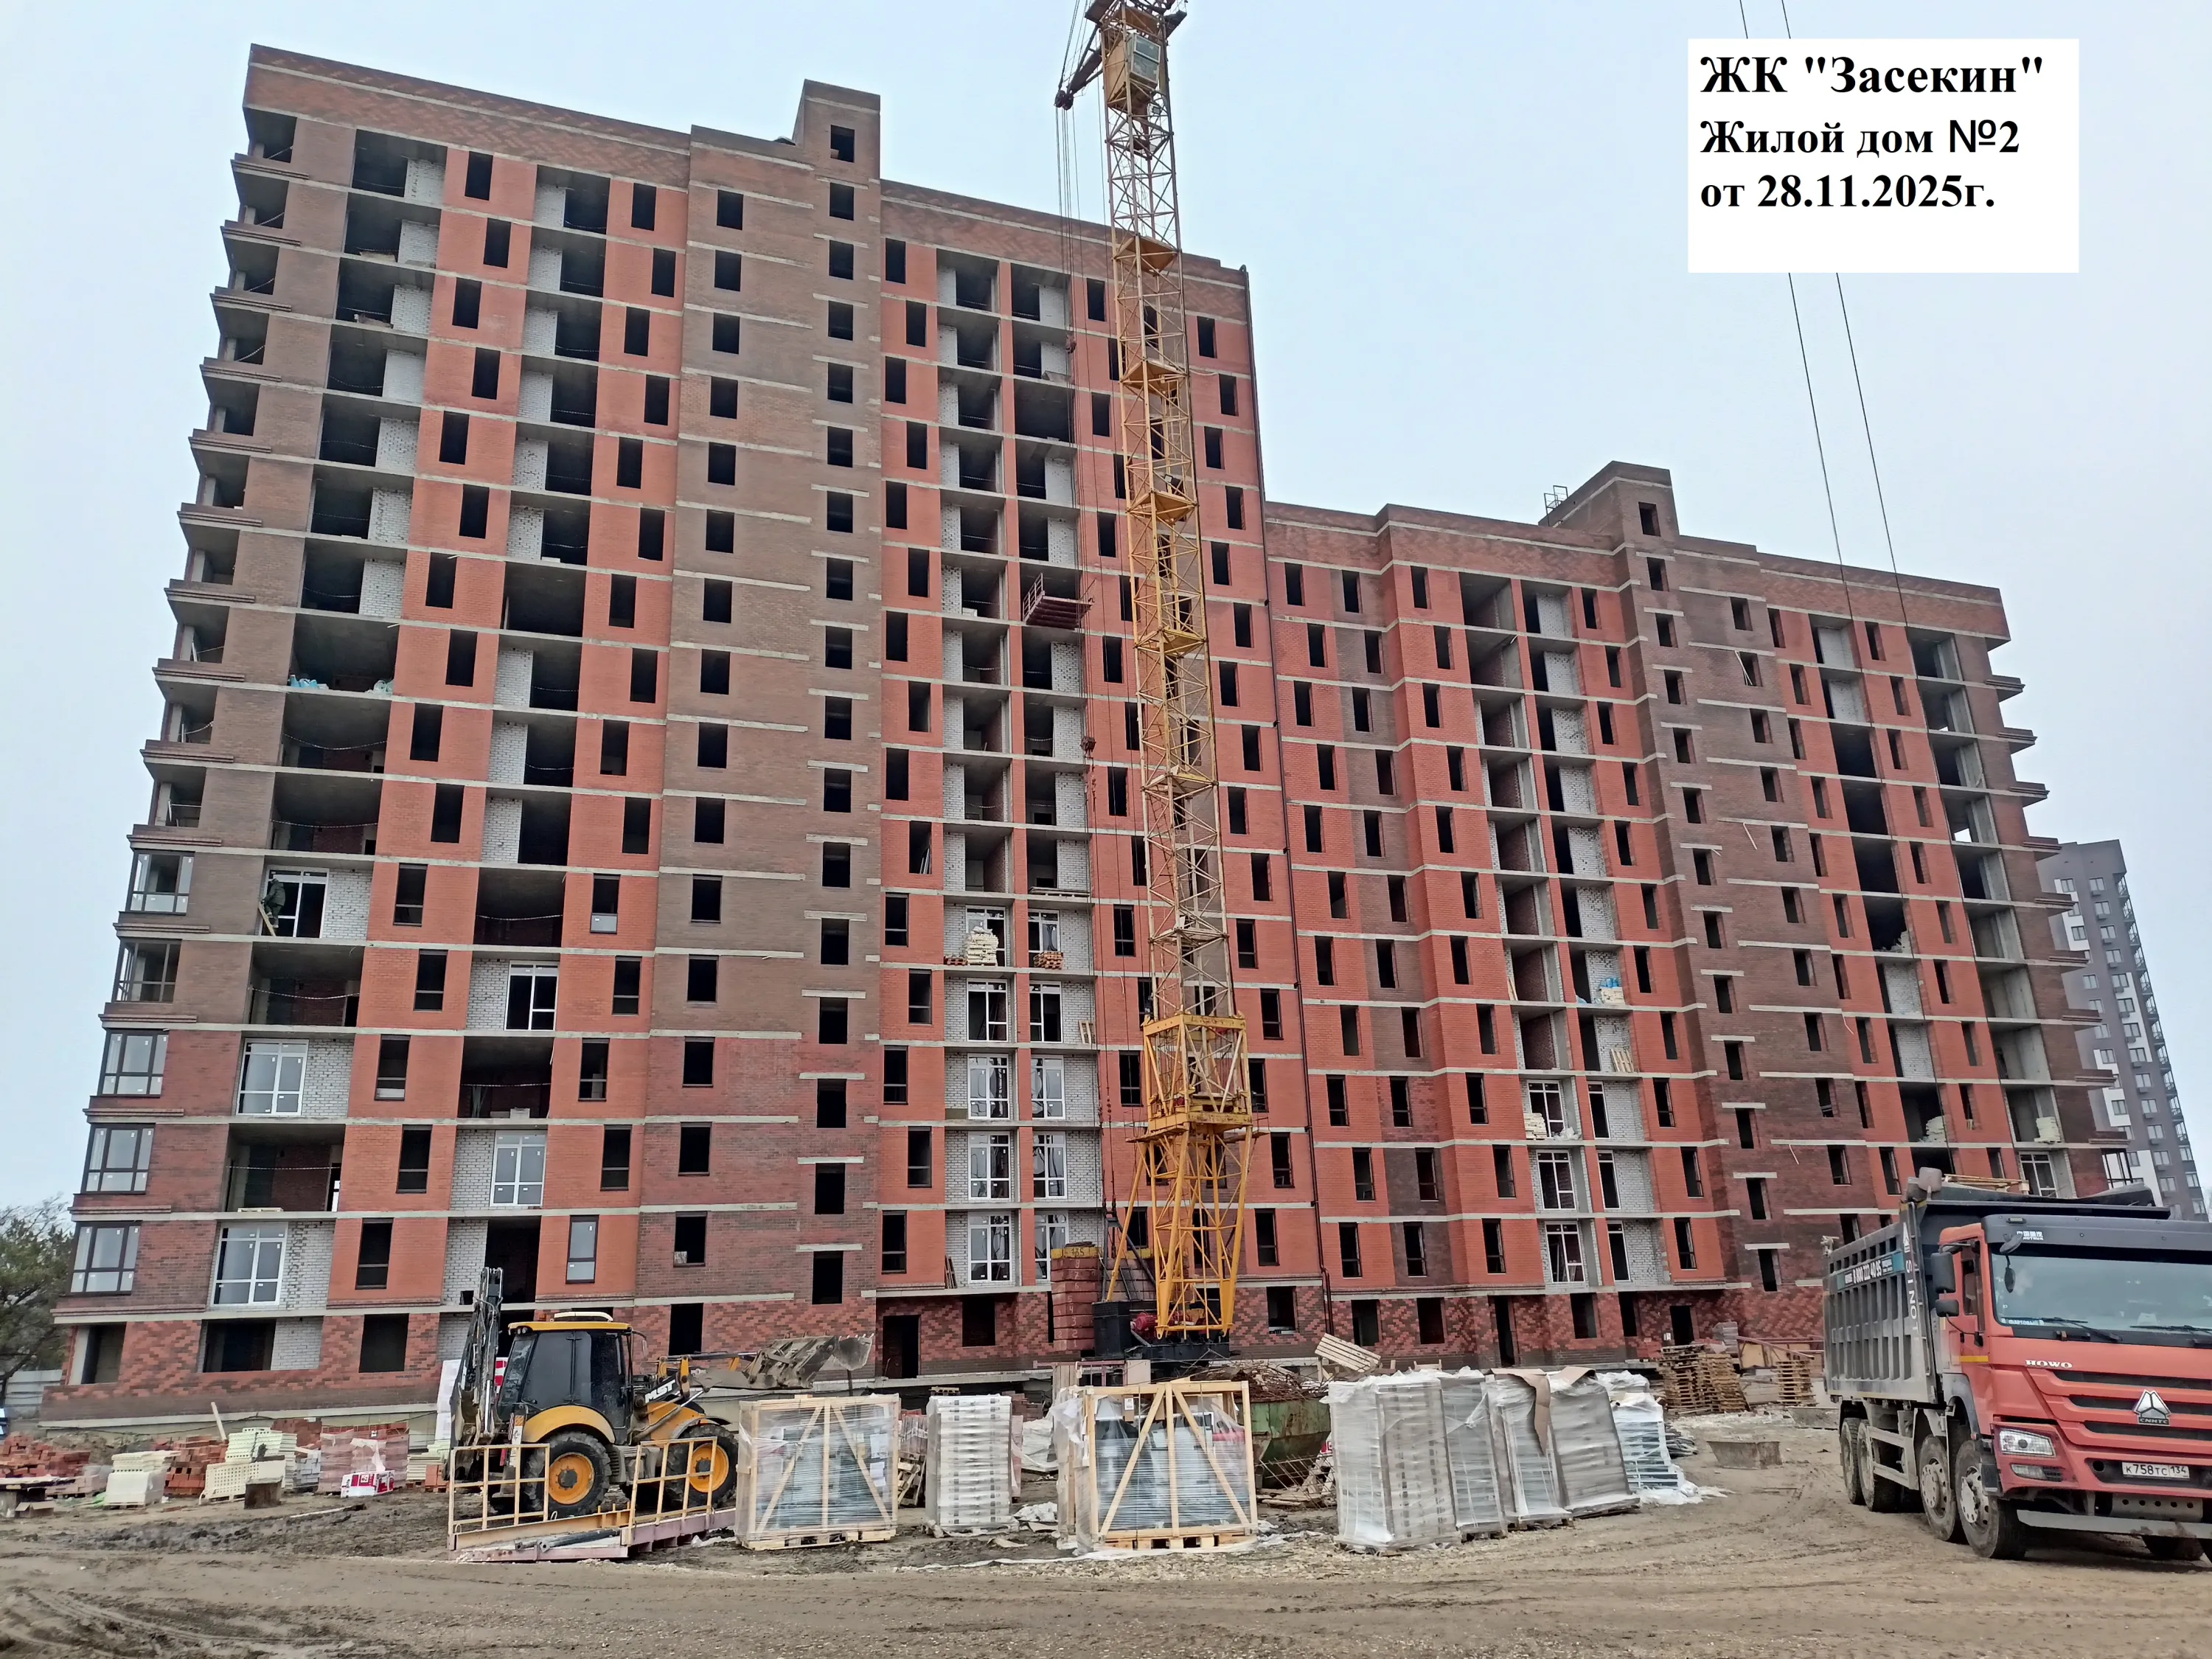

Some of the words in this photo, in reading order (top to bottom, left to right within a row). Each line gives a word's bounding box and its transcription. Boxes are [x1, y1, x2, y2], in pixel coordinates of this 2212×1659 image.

[1072, 1329, 1078, 1338] 2
[2025, 1360, 2073, 1369] HOWO
[644, 1379, 676, 1404] MST
[2170, 1465, 2187, 1475] 134
